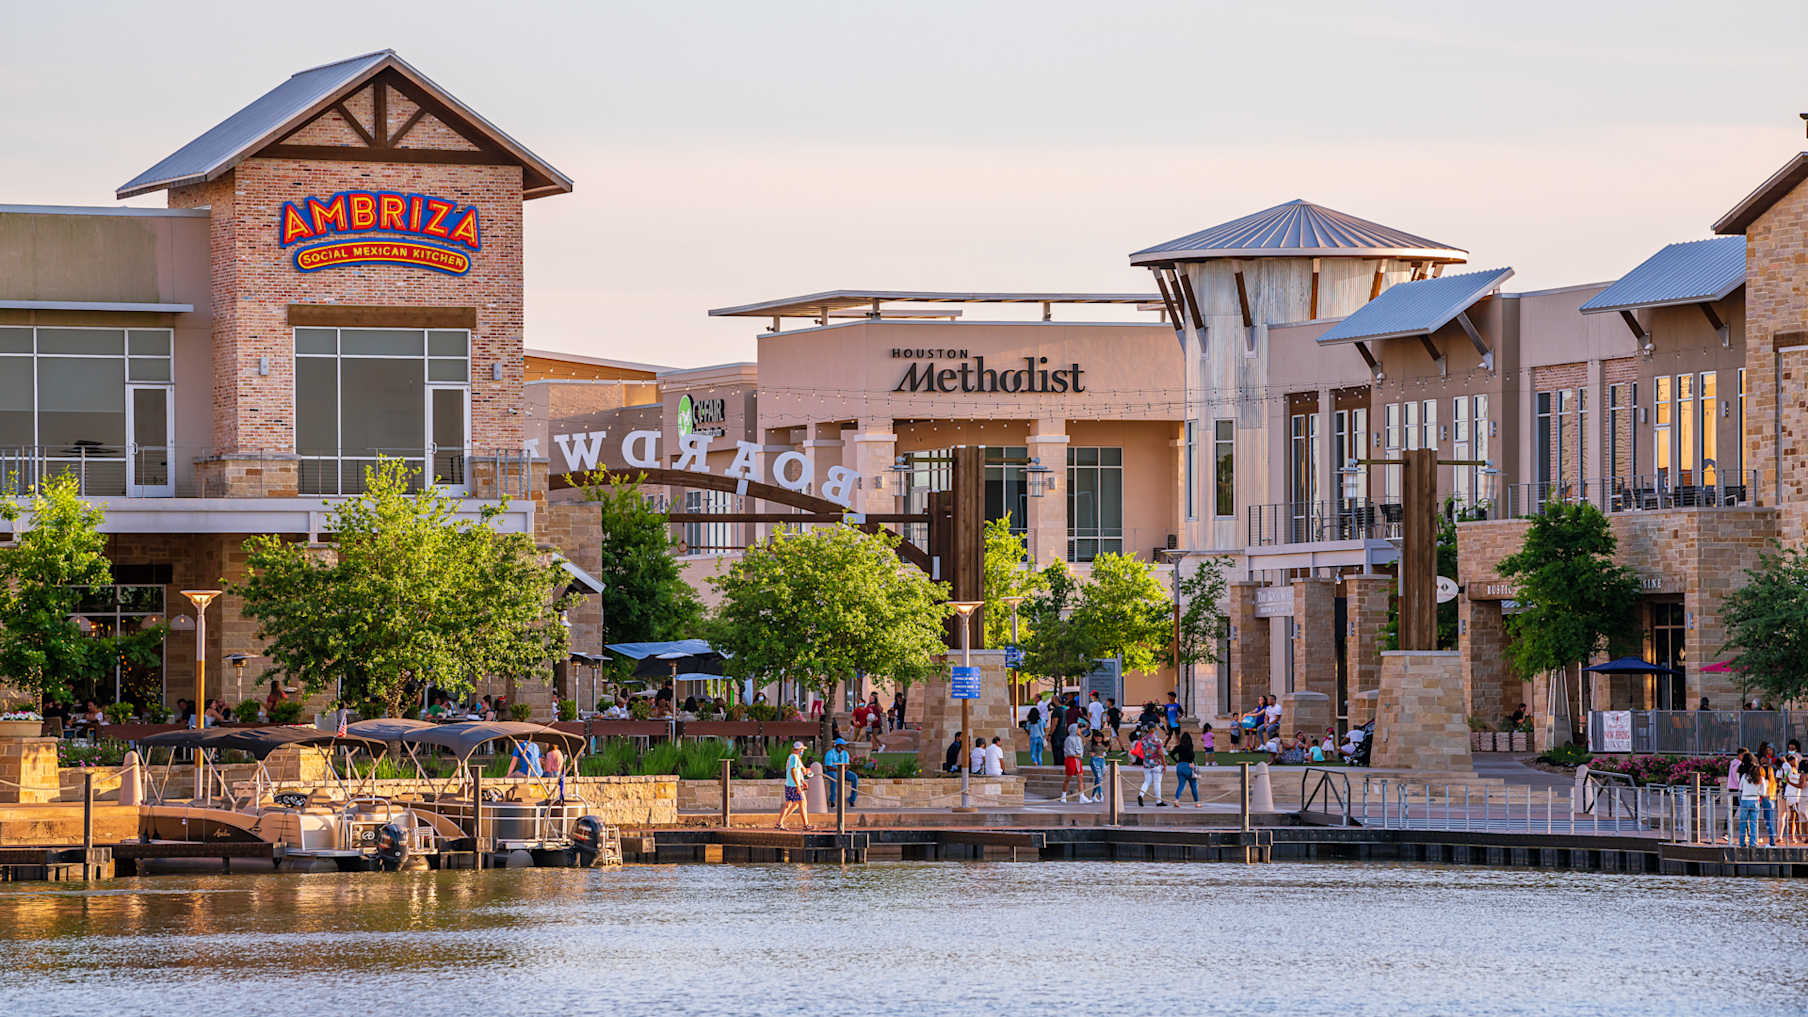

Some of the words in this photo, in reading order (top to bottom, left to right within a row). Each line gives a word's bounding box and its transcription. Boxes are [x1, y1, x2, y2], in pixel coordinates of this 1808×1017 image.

[282, 192, 479, 249] AMBRIZA
[303, 247, 348, 265] SOCIAL
[353, 247, 407, 257] MEXICAN
[412, 247, 464, 267] KITCHEN
[892, 348, 969, 359] HOUSTON
[892, 356, 1085, 393] Methodist
